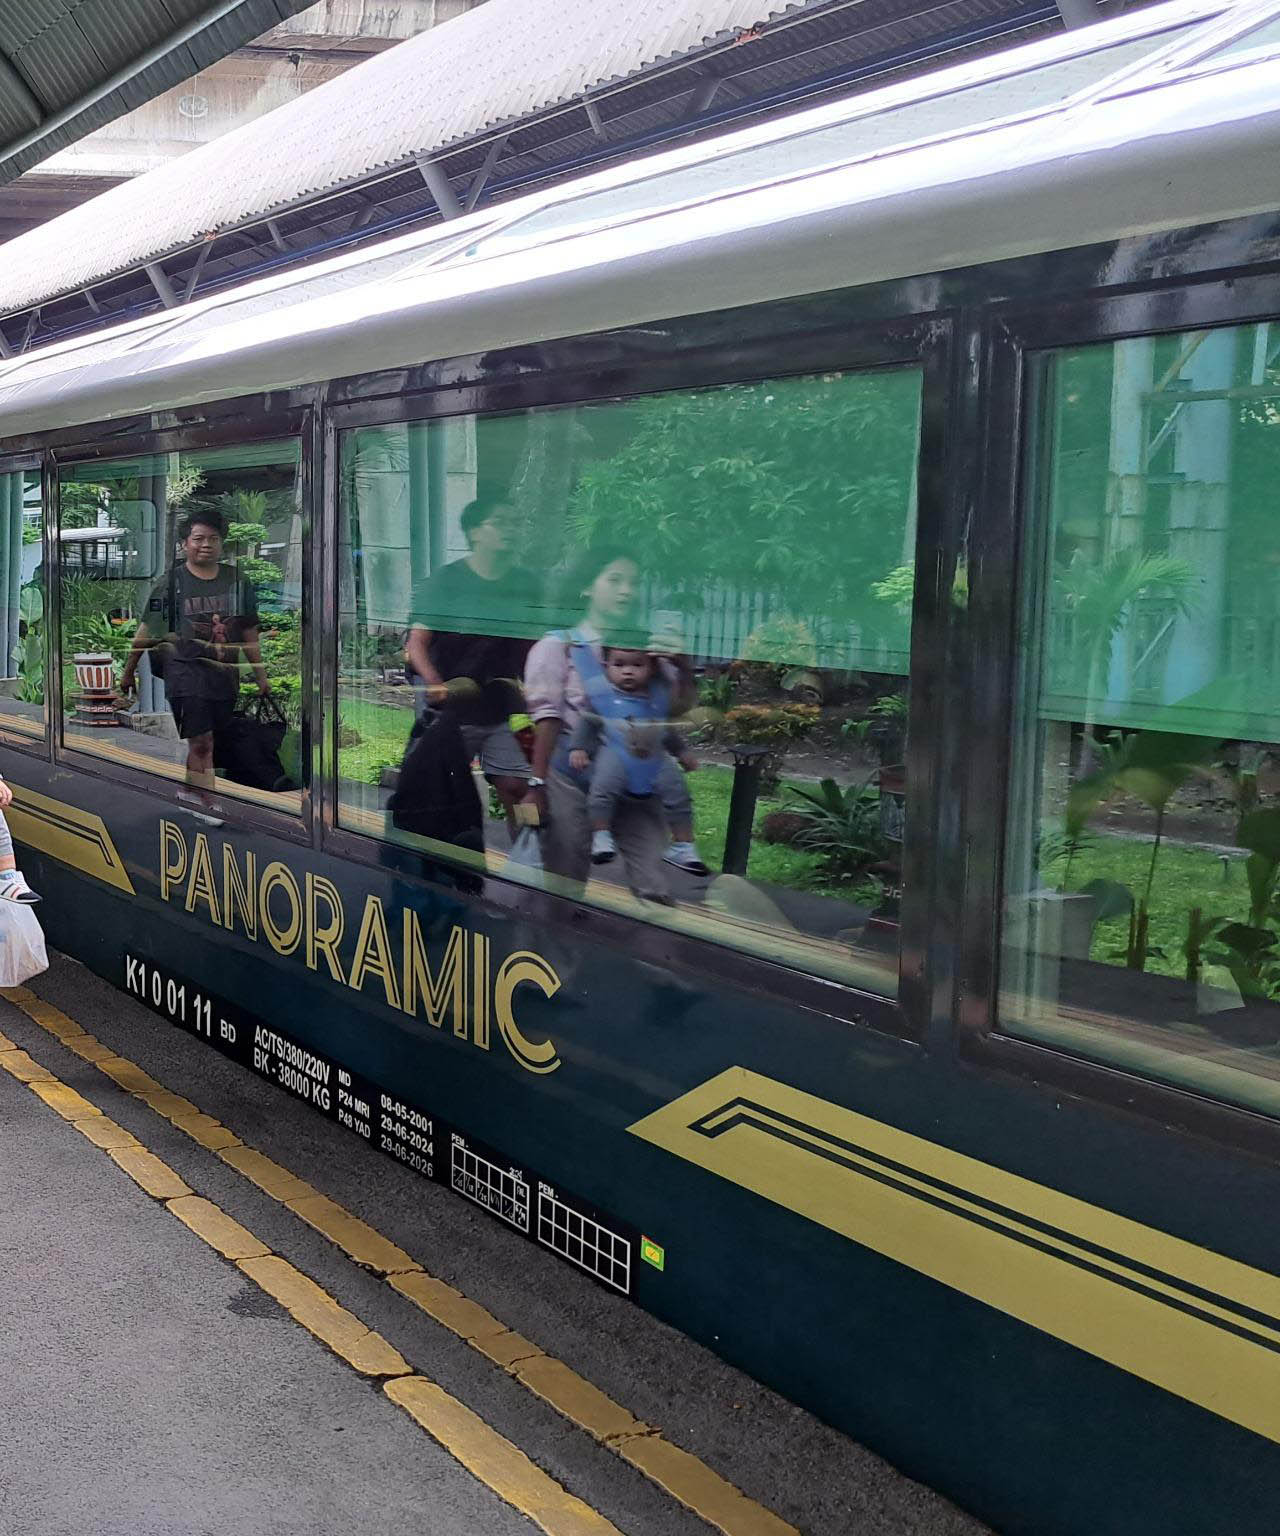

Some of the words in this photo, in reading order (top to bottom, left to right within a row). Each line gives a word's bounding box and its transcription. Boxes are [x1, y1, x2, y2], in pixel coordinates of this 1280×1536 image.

[160, 818, 562, 1074] PANORAMIC
[126, 954, 146, 998] K1
[167, 979, 185, 1022] 01
[193, 993, 211, 1037] 11
[220, 1018, 236, 1043] BD
[254, 1025, 330, 1085] AC/TS/380/220V
[254, 1047, 269, 1075] BK
[278, 1062, 310, 1098] 38000
[312, 1082, 331, 1110] KG
[338, 1069, 352, 1087] MD
[381, 1094, 433, 1135] 08-05-2001
[338, 1088, 354, 1109] P24
[354, 1097, 370, 1119] MRI
[381, 1114, 433, 1156] 29-06-2024
[338, 1108, 353, 1129] P48
[353, 1117, 371, 1139] YAD
[381, 1134, 433, 1177] 29-06-2026
[538, 1181, 554, 1198] PEM
